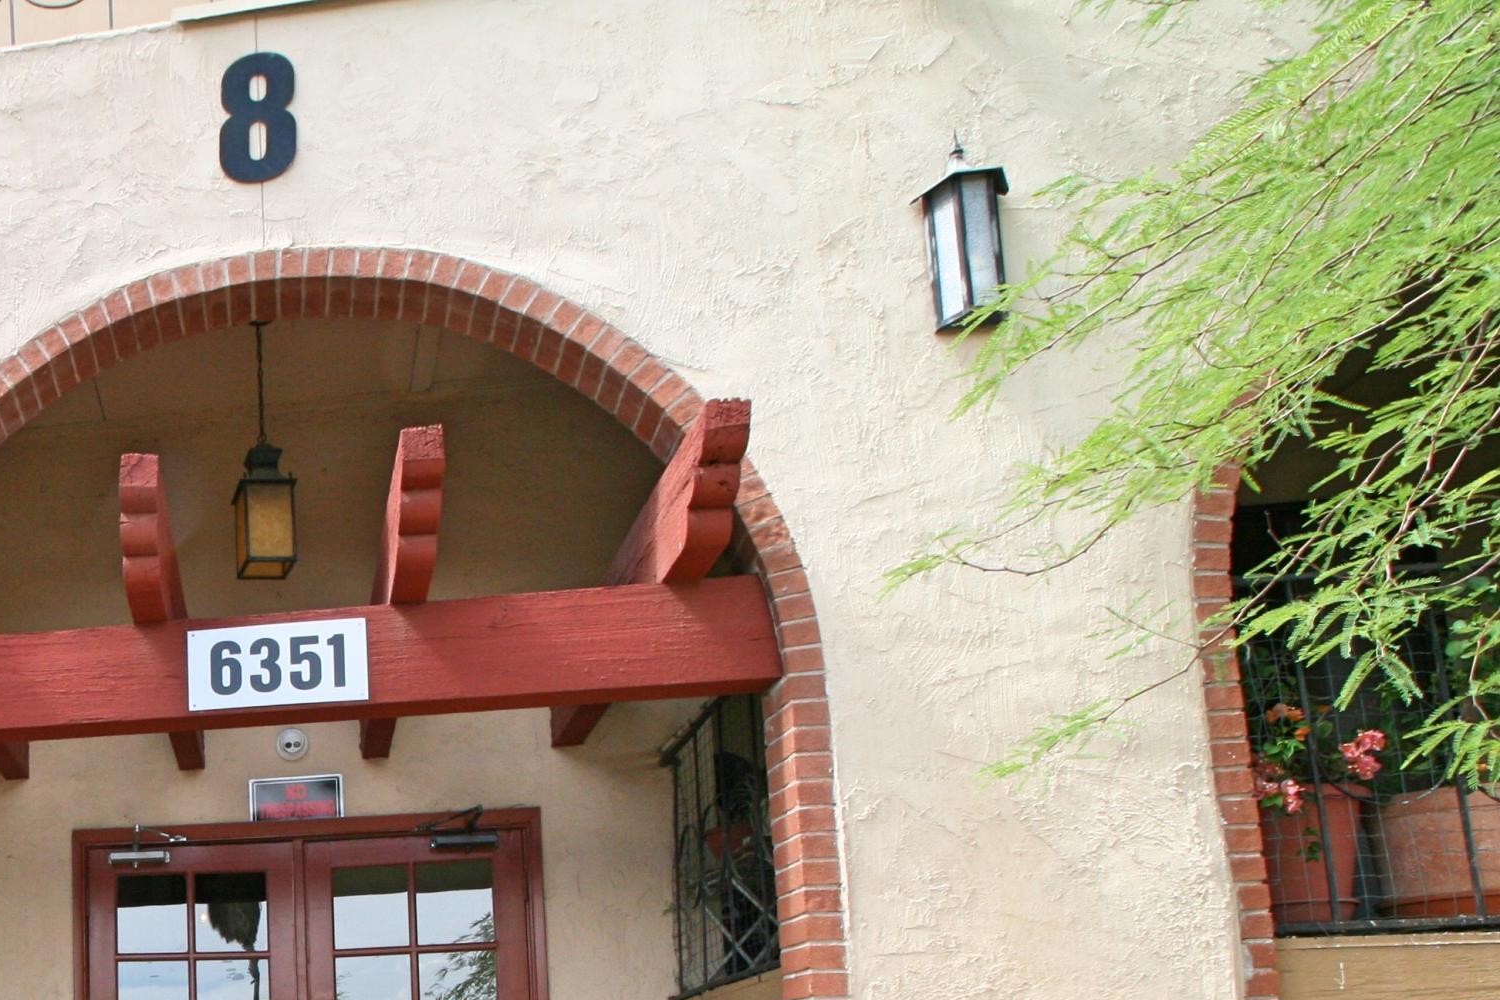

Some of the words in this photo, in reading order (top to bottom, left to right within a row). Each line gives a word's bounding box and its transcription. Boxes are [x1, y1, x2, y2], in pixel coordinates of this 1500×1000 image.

[219, 52, 297, 184] 8
[210, 633, 347, 696] 6351
[285, 783, 308, 801] NO
